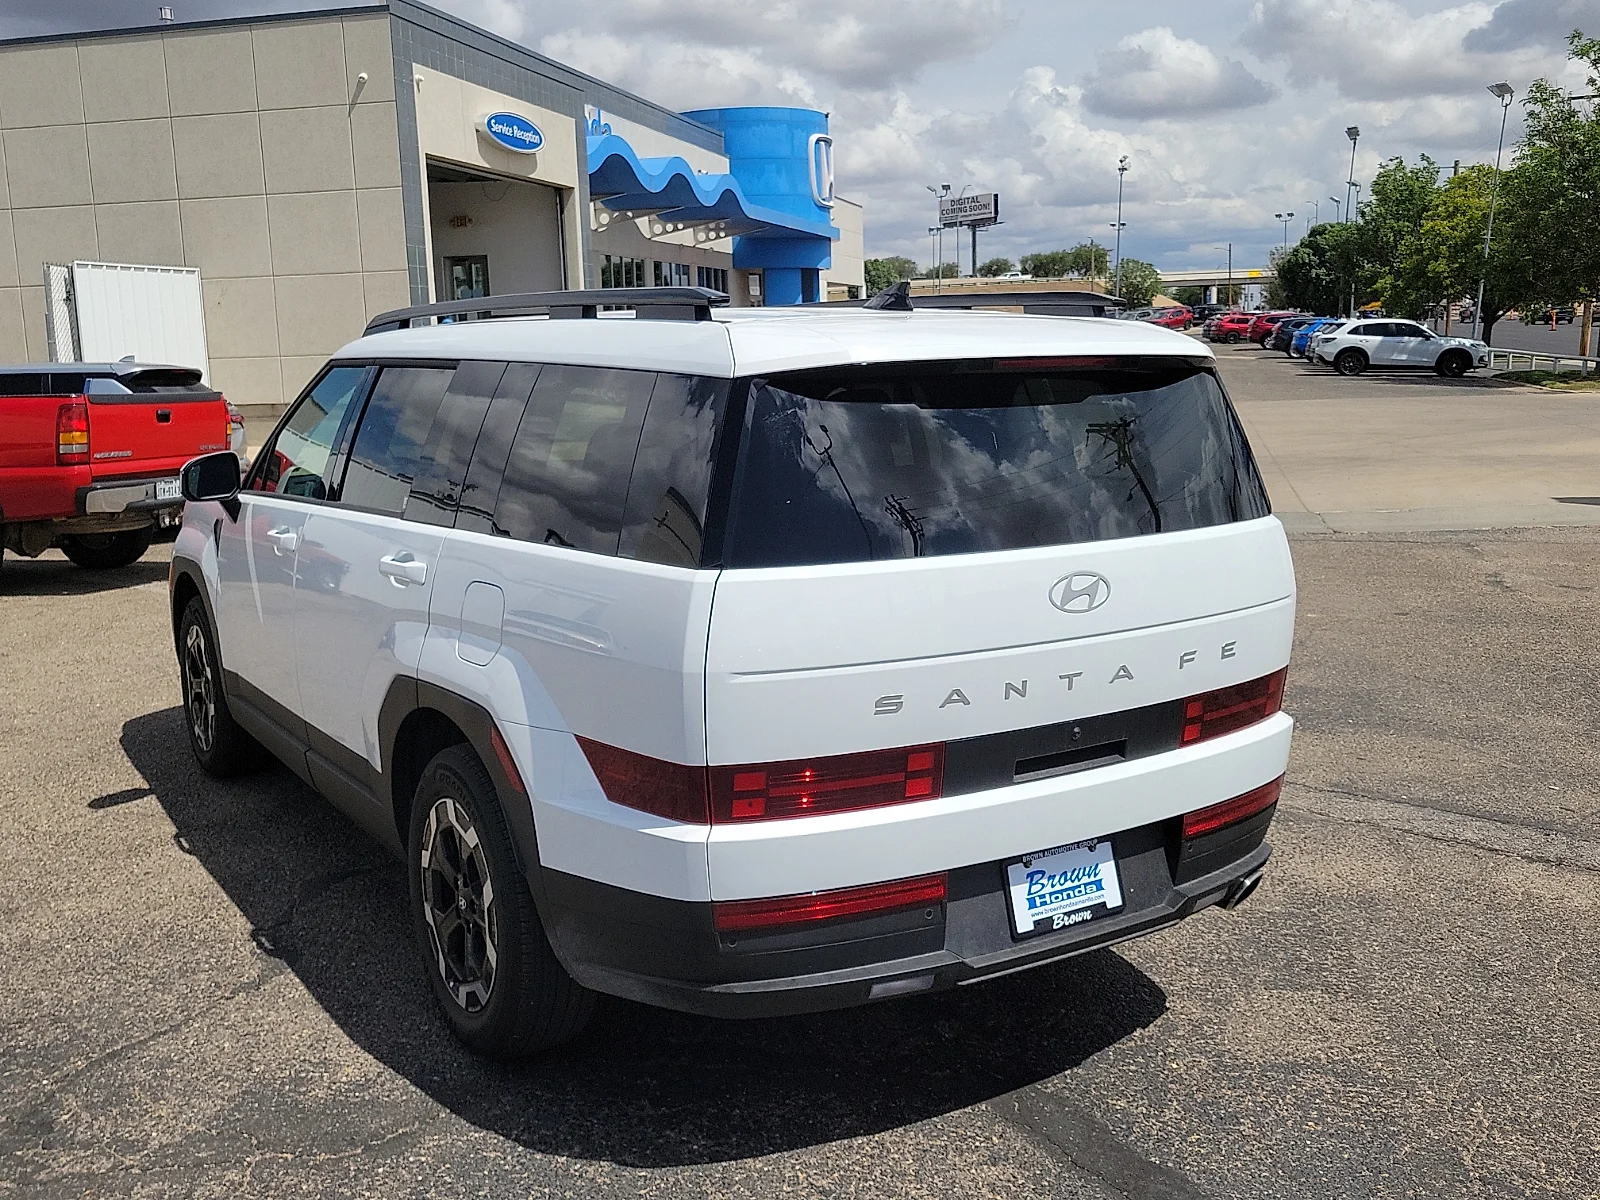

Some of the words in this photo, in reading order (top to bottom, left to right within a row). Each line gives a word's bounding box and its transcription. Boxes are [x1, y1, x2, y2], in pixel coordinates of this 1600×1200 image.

[490, 118, 513, 136] Service
[513, 124, 540, 144] Reception
[941, 206, 968, 216] COMING
[968, 203, 990, 212] SOON!
[950, 196, 980, 207] DIGITAL
[874, 664, 1134, 716] SANTA
[1179, 640, 1237, 670] FE
[1022, 851, 1043, 862] BROWN
[1044, 844, 1079, 857] AUTOMOTIVE
[1079, 839, 1098, 849] GROUP
[1026, 863, 1101, 896] Brown
[1034, 883, 1097, 907] Honda
[1052, 910, 1093, 930] Brown
